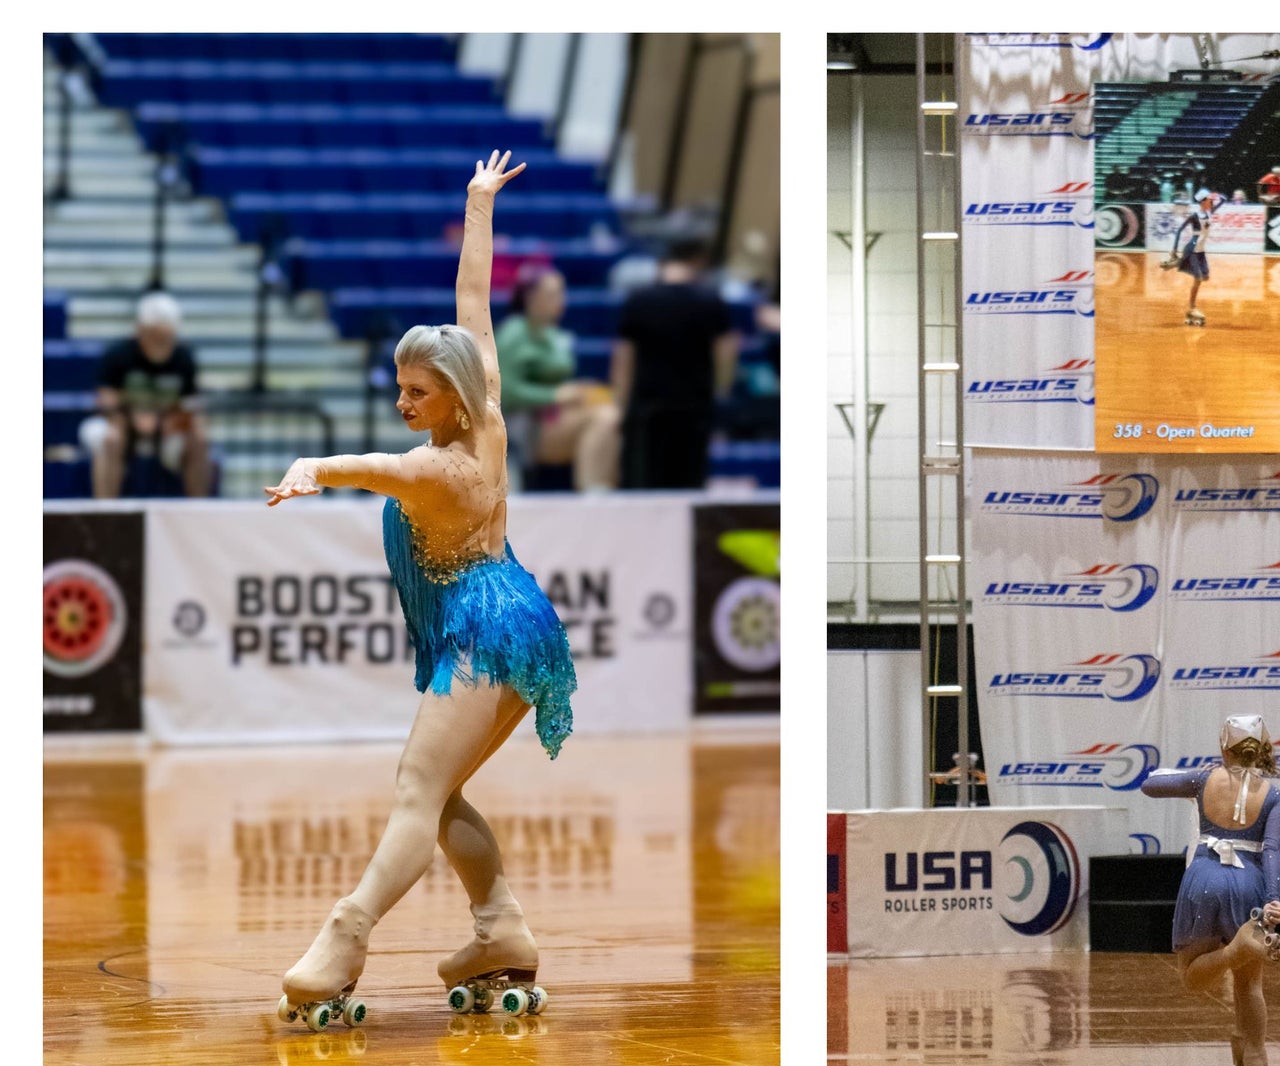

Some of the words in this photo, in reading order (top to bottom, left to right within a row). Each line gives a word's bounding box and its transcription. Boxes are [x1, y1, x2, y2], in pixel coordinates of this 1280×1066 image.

[965, 112, 1075, 126] usars
[965, 201, 1077, 215] usars
[965, 290, 1078, 305] usars
[967, 378, 1078, 393] usars
[1113, 423, 1142, 438] 358
[1156, 423, 1195, 441] Open
[1200, 423, 1254, 438] Quartet
[984, 491, 1105, 506] usars
[985, 583, 1106, 596] usars
[989, 673, 1106, 688] usars
[885, 851, 992, 892] USA
[885, 897, 936, 913] ROLLER
[942, 896, 993, 912] SPORTS
